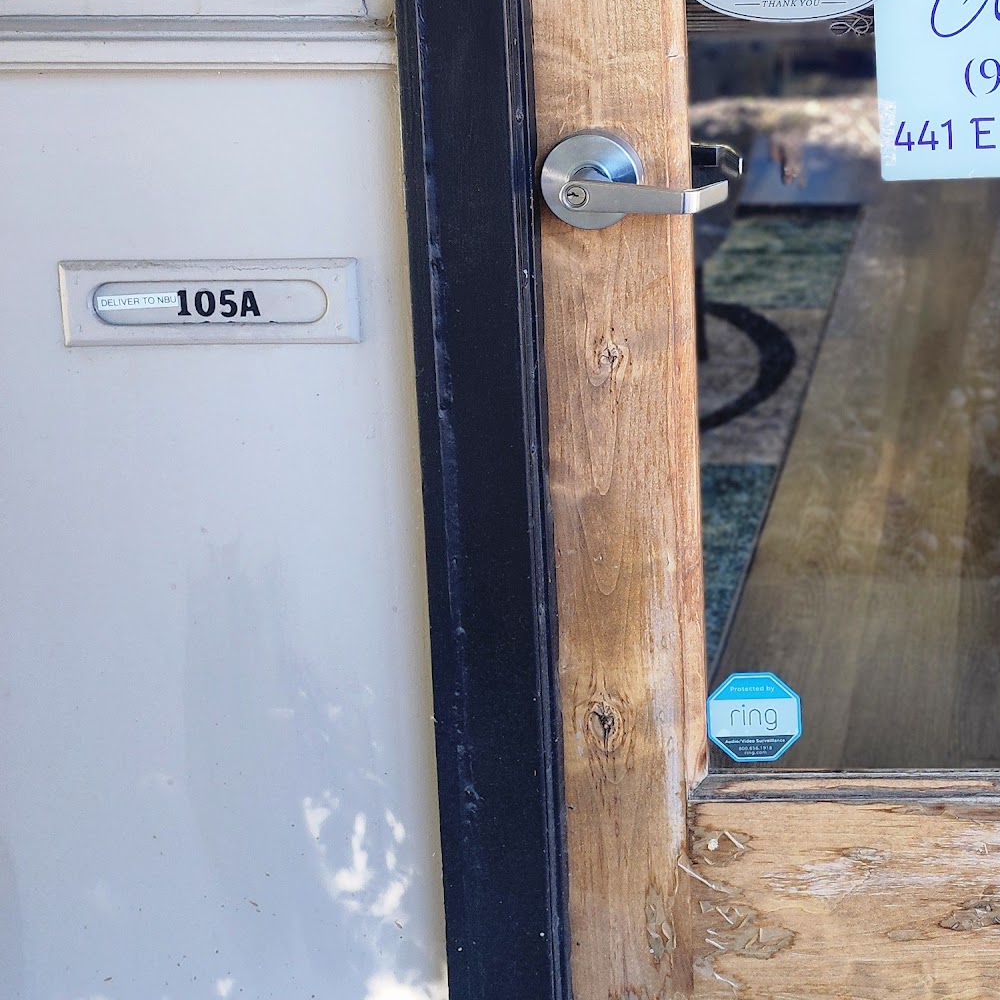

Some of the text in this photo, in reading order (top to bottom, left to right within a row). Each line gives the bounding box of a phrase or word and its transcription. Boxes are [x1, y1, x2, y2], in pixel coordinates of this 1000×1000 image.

[762, 0, 820, 8] THANK YOU
[894, 119, 953, 152] 441
[969, 116, 997, 150] E
[101, 298, 140, 307] DELIVER
[142, 297, 155, 305] TO
[177, 289, 261, 318] 105A
[730, 704, 778, 731] ring
